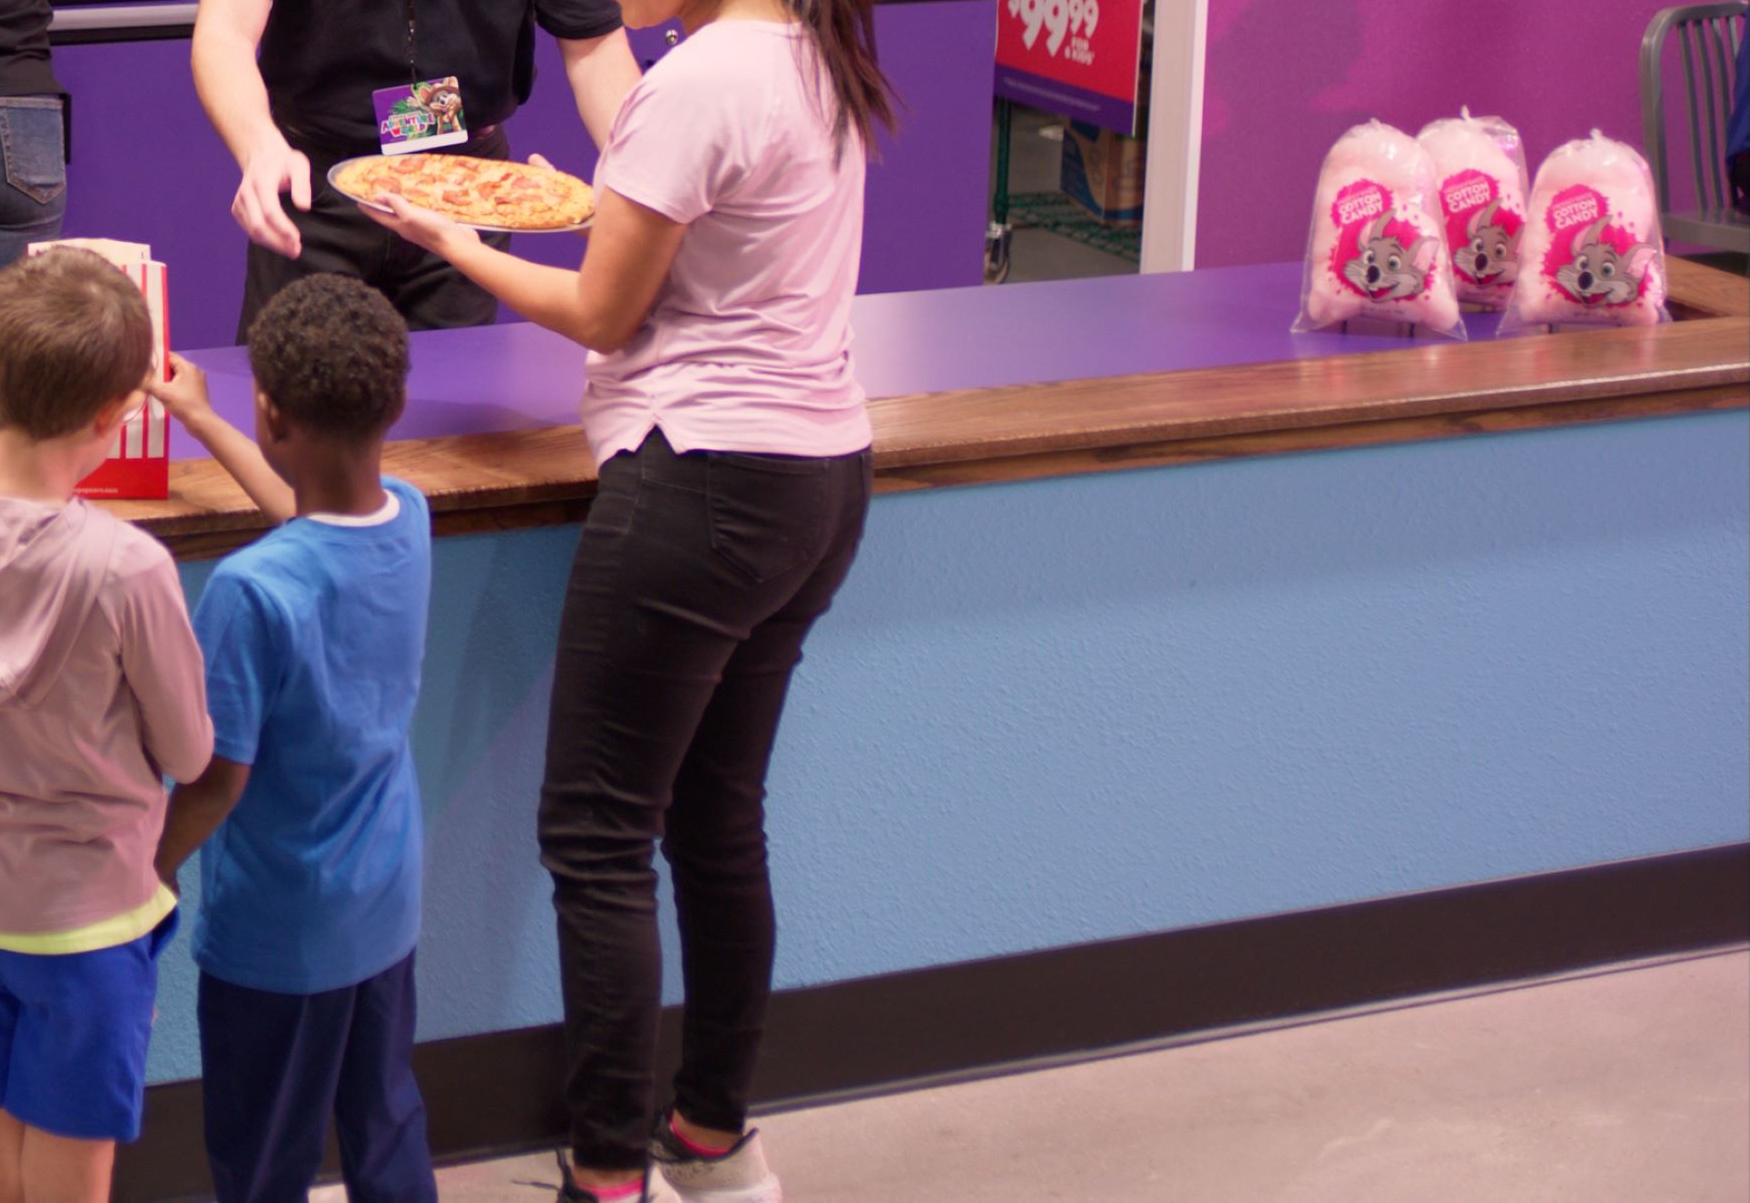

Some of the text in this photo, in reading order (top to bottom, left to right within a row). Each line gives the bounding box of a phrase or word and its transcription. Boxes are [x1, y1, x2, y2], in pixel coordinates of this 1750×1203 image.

[1446, 180, 1490, 202] COTTON
[1338, 191, 1383, 216] COTTON
[1340, 202, 1383, 225] CANDY
[1449, 193, 1491, 213] CANDY
[1553, 199, 1597, 217] COTTON
[1556, 208, 1598, 229] CANDY
